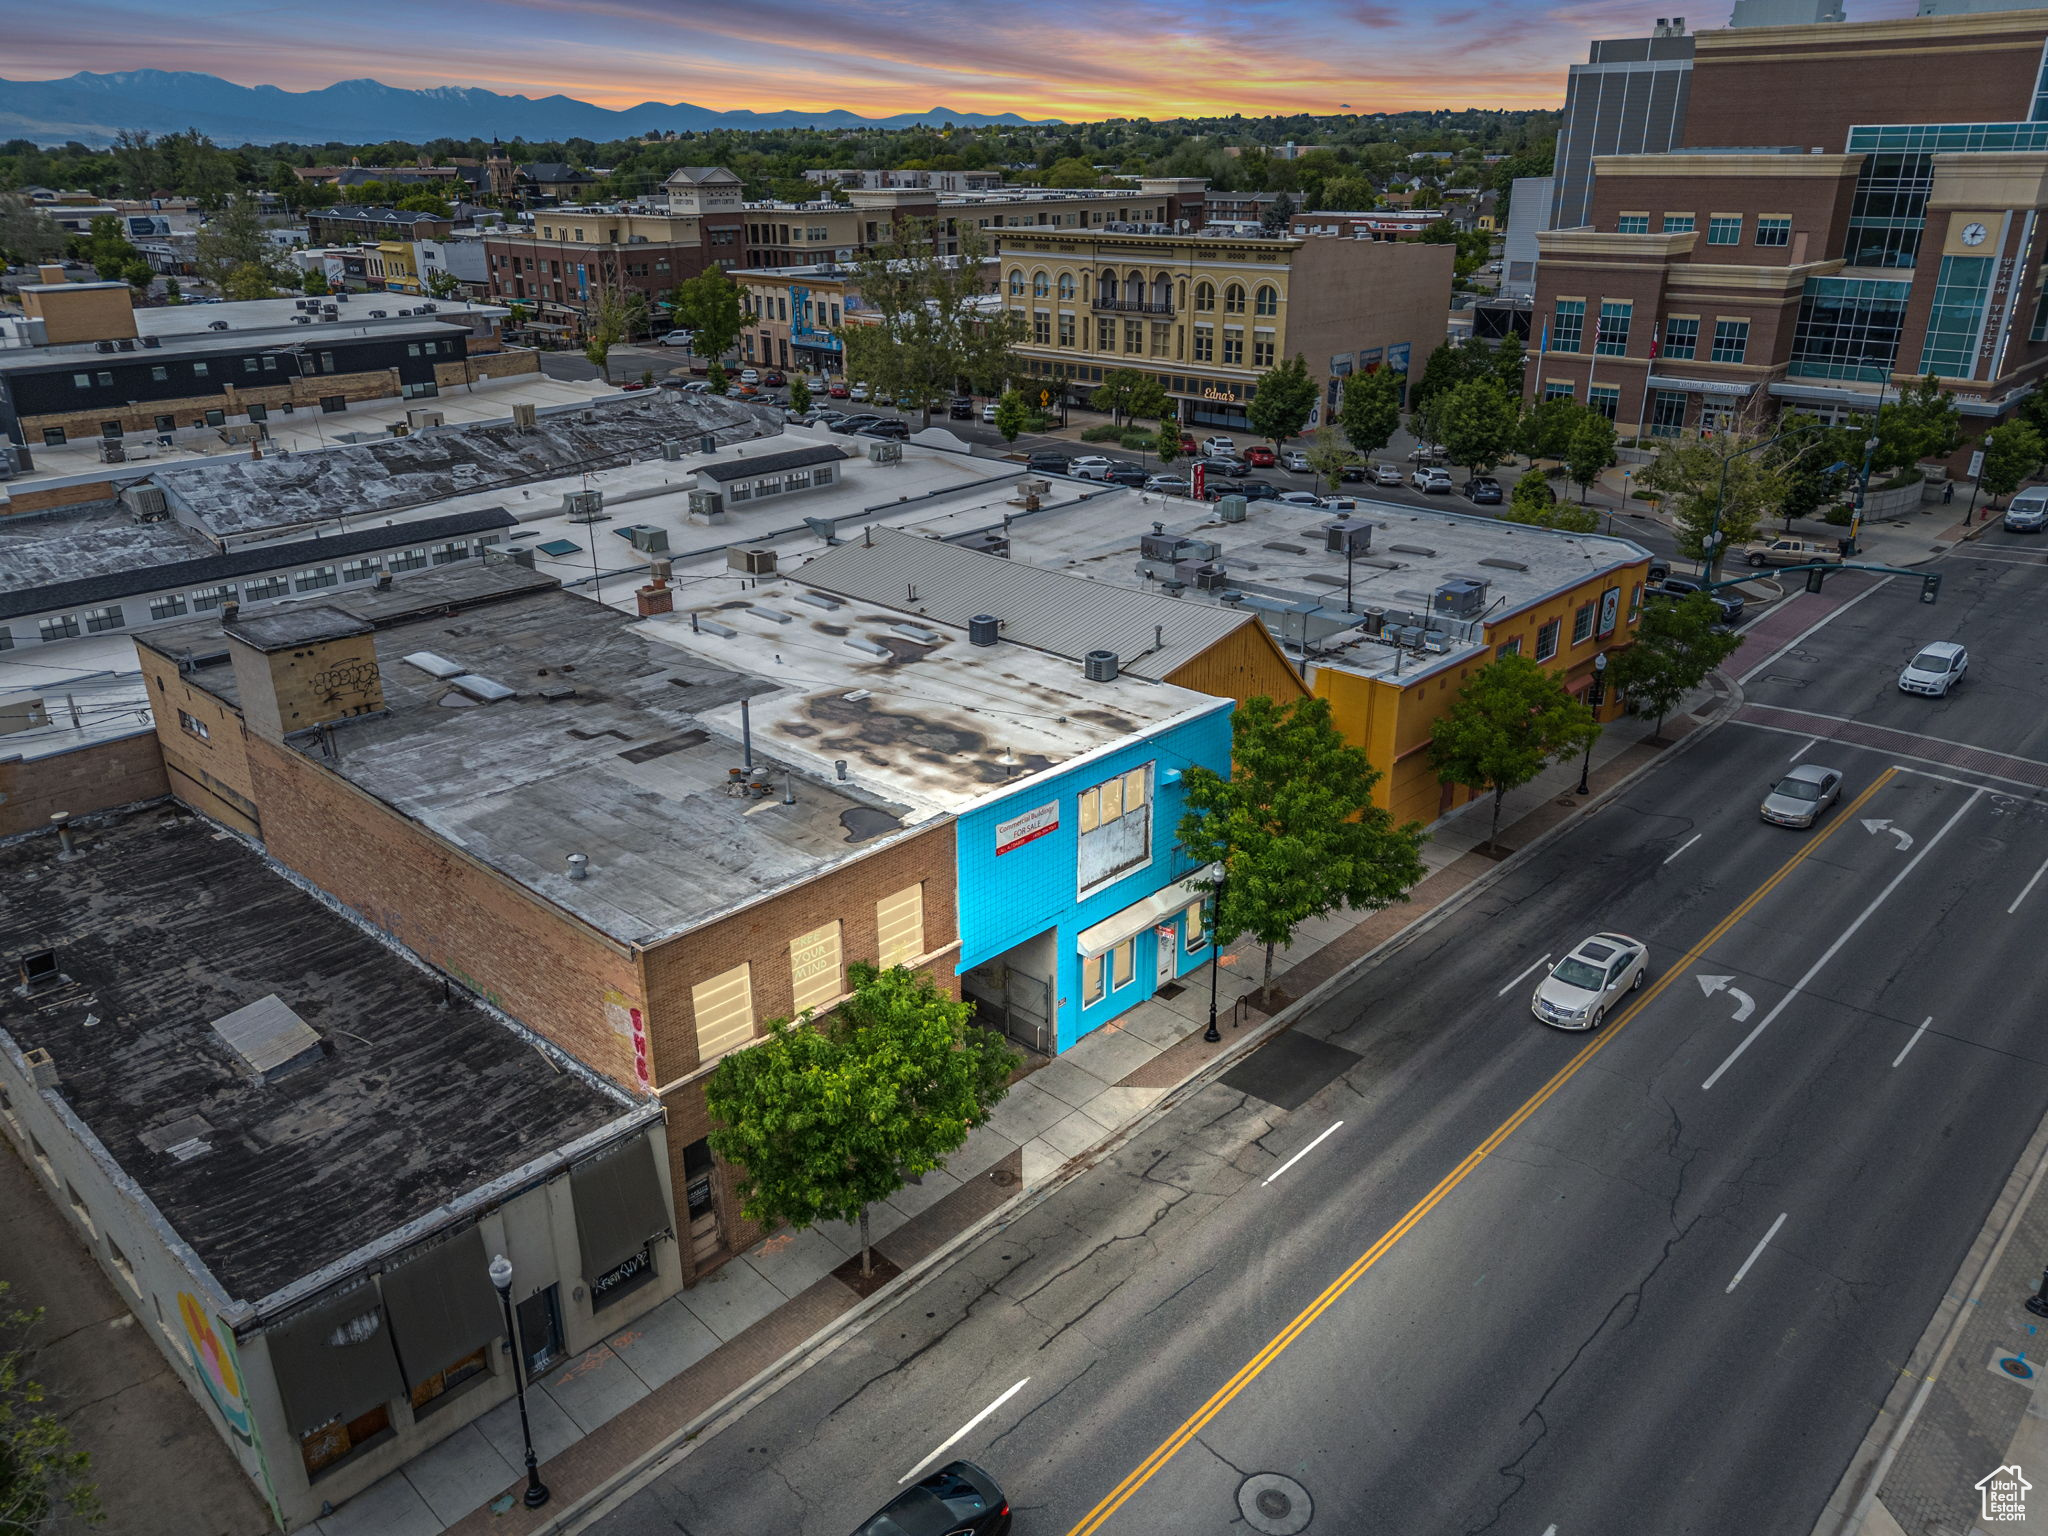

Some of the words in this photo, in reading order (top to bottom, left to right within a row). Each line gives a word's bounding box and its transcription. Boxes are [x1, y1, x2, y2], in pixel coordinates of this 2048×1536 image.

[1997, 257, 2012, 295] UTAH
[1983, 304, 2000, 358] VALLEY
[1204, 387, 1235, 401] Edna's
[999, 814, 1030, 834] Commercial
[1013, 826, 1026, 839] FOR
[1026, 820, 1041, 832] SALE
[793, 945, 826, 966] YOUR
[794, 959, 827, 982] MIND
